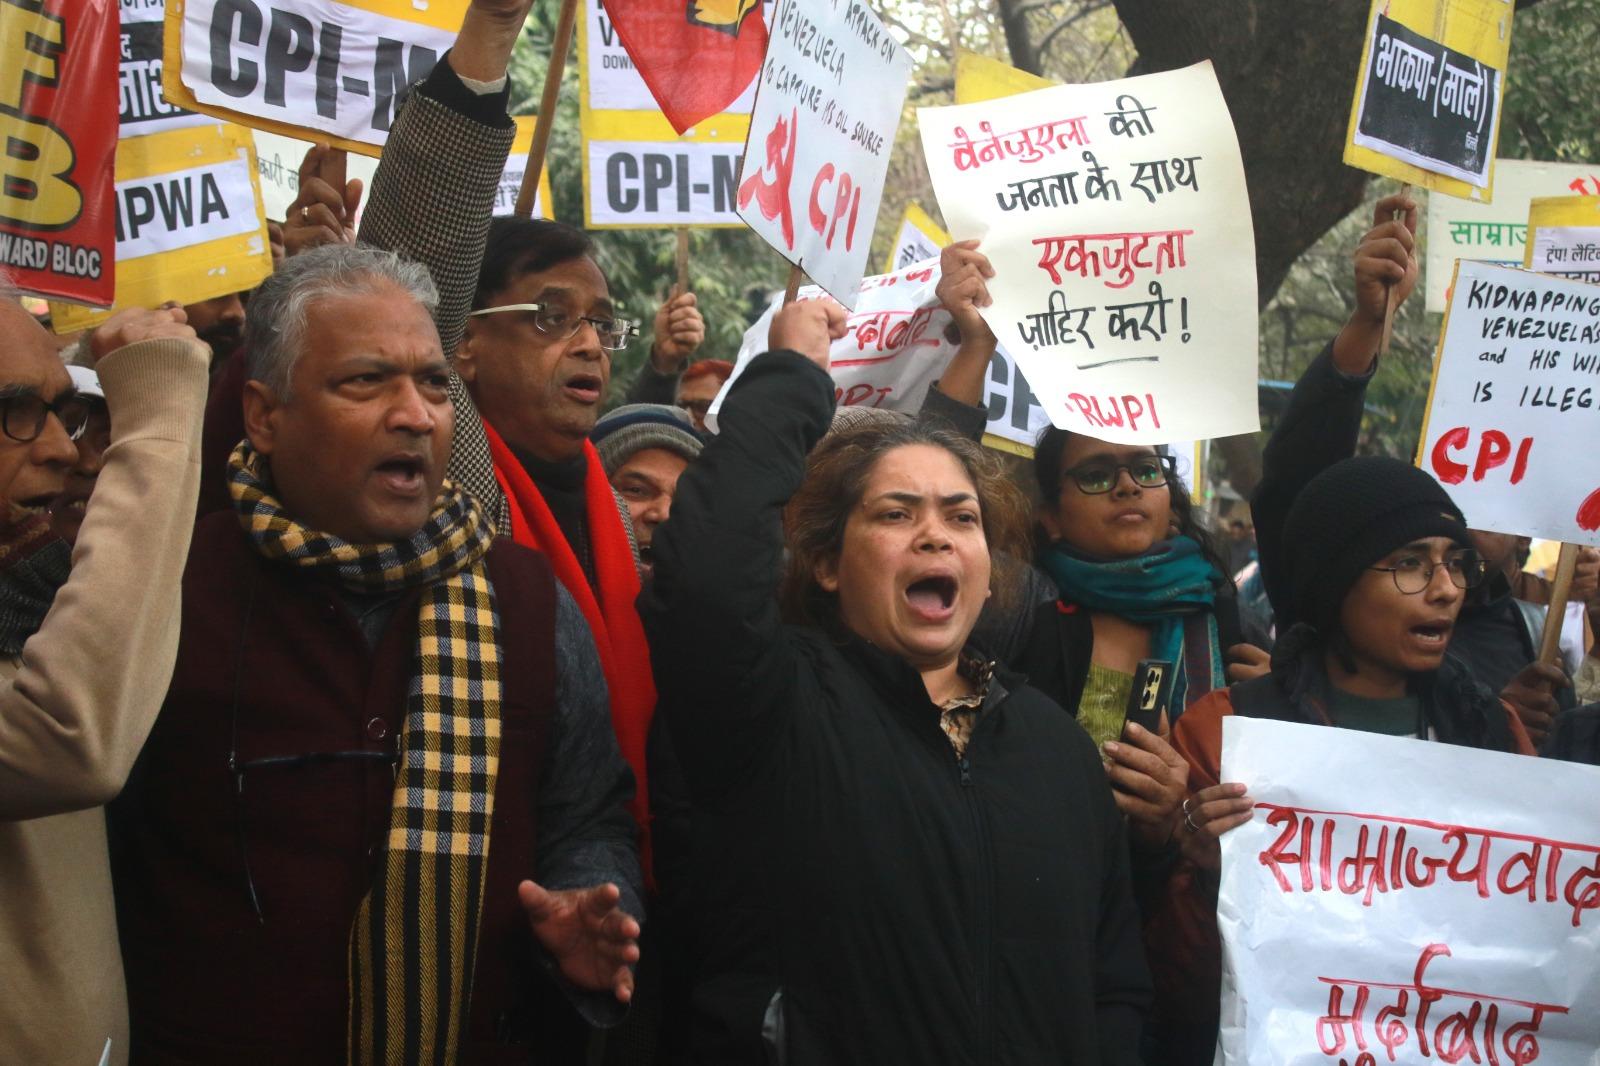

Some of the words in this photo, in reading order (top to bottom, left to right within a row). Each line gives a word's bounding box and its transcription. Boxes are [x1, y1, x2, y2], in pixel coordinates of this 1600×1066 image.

[779, 0, 846, 86] VENEZUELA
[880, 37, 896, 64] ON
[776, 64, 822, 113] CAPTURE
[836, 109, 849, 134] OIL
[850, 120, 884, 156] SOURCE
[1104, 95, 1157, 138] की
[996, 171, 1080, 213] जनता
[1082, 151, 1122, 201] के
[1130, 156, 1202, 204] साथ
[808, 162, 861, 252] CPI
[52, 243, 101, 279] BLOC
[1032, 229, 1194, 289] एकजुटता
[1467, 280, 1600, 317] KIDNAPPING
[1479, 347, 1506, 364] and
[1529, 349, 1560, 370] HIS
[1068, 393, 1160, 431] RWPI
[1473, 381, 1492, 403] IS
[1520, 385, 1600, 412] ILLEG
[1431, 427, 1533, 485] CPI
